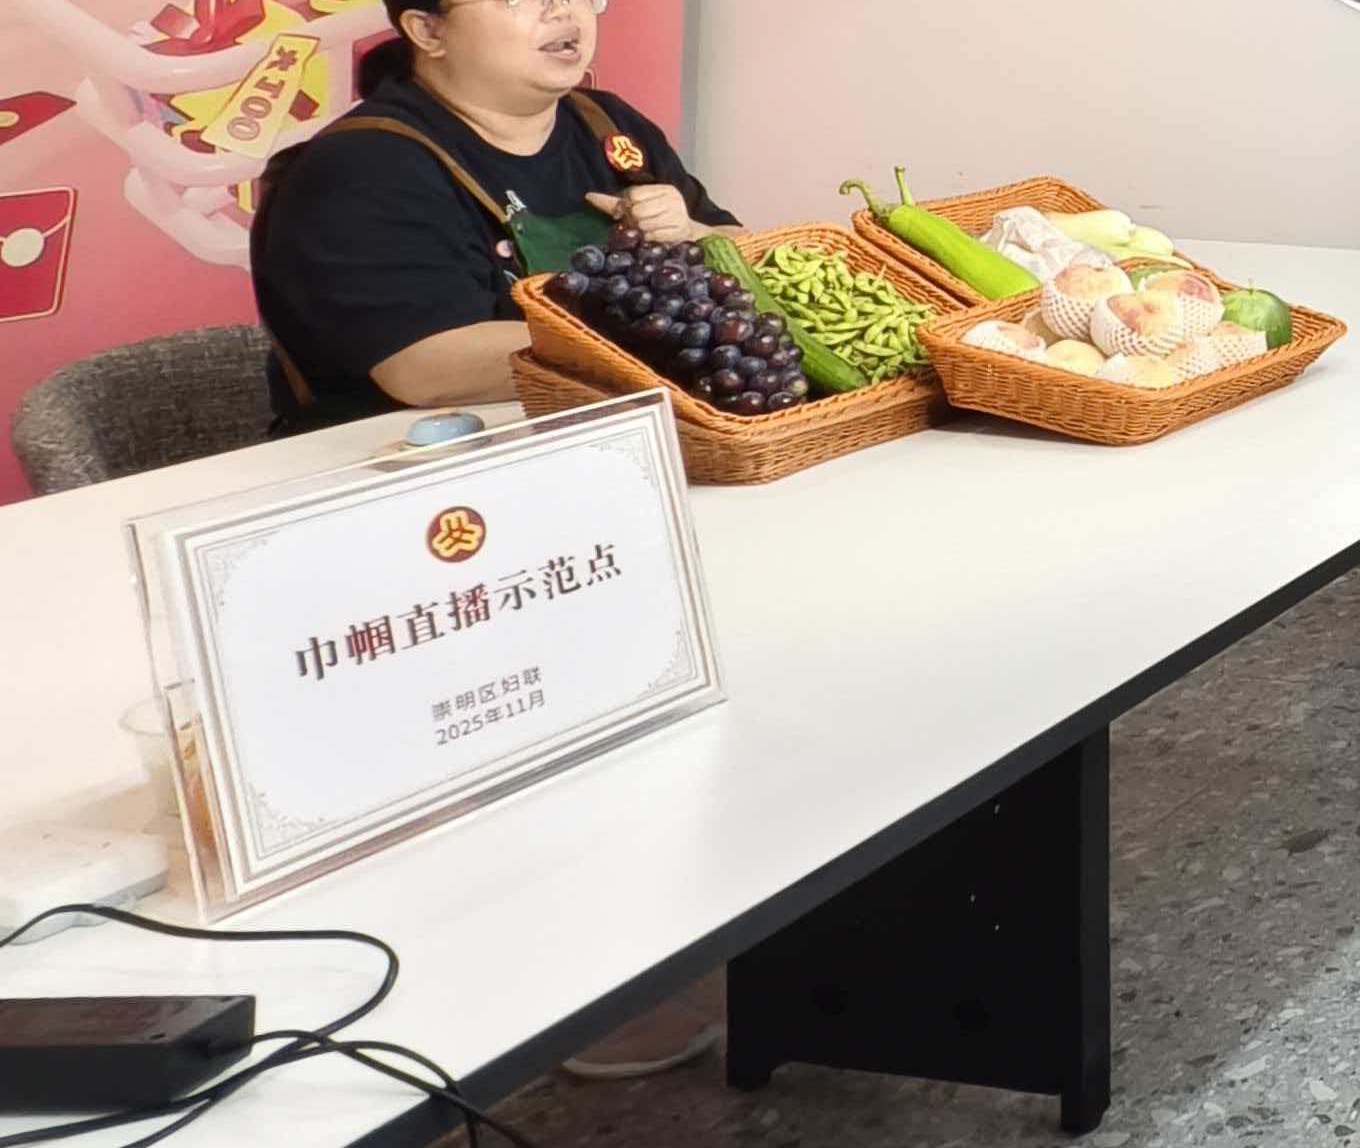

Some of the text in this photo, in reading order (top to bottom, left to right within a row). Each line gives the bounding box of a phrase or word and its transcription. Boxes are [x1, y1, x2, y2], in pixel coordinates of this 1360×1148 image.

[294, 543, 623, 680] 巾帼直播示范点
[432, 666, 542, 722] 崇明区妇联
[435, 689, 545, 745] 2025年11月
